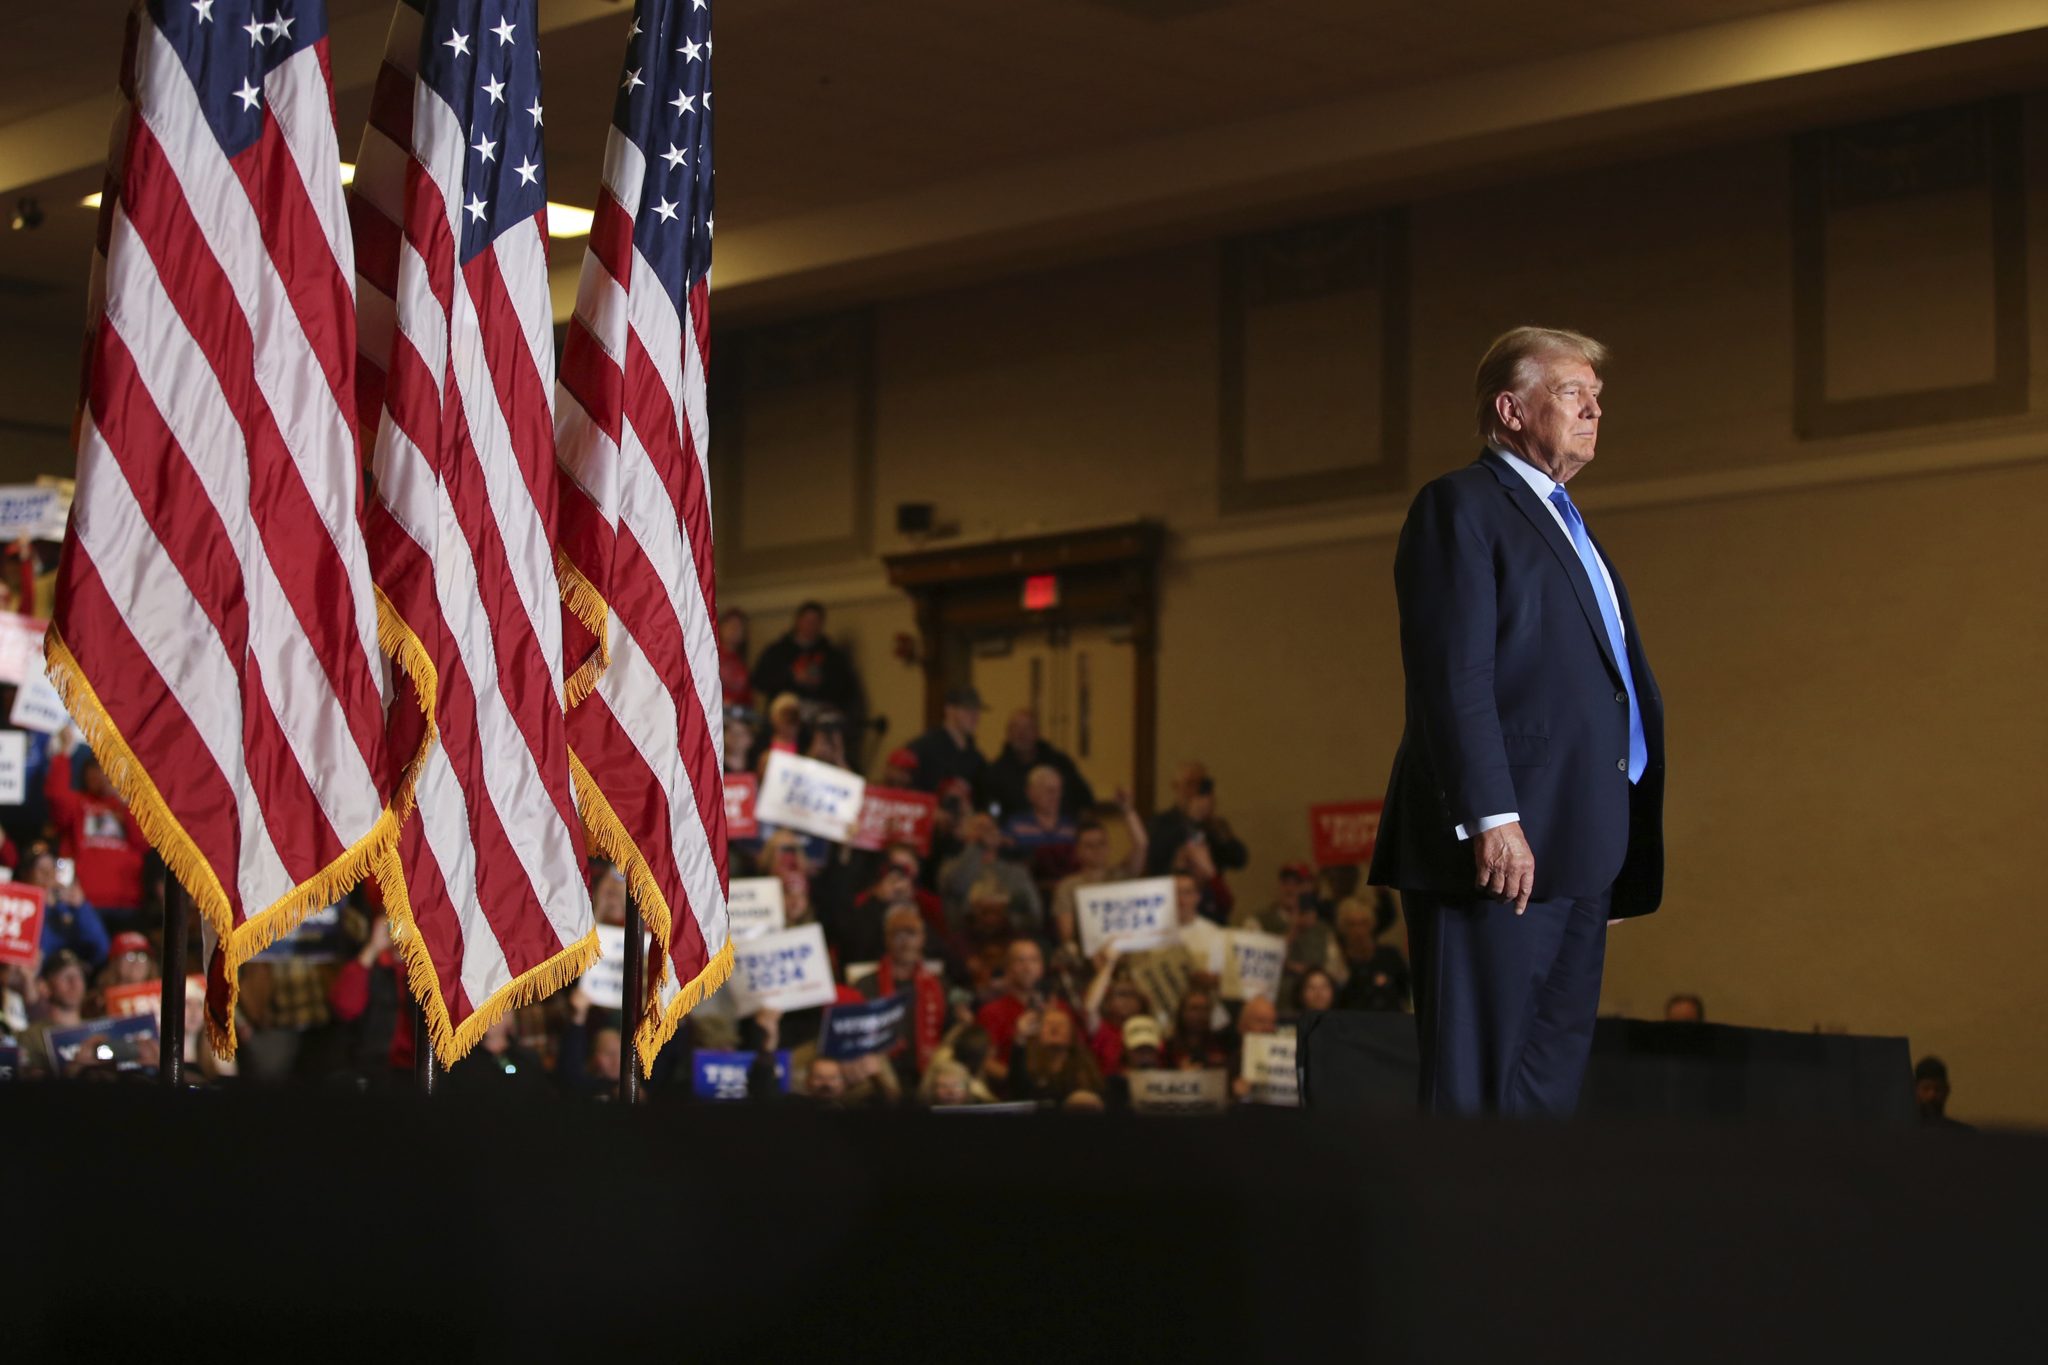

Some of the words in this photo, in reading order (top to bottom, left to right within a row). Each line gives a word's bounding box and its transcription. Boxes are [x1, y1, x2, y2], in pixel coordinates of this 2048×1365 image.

[781, 769, 851, 801] TRUMP
[784, 789, 836, 815] 2024
[1088, 895, 1166, 917] TRUMP
[1101, 912, 1156, 934] 2024
[733, 943, 814, 973] TRUMP
[747, 963, 815, 993] 2024
